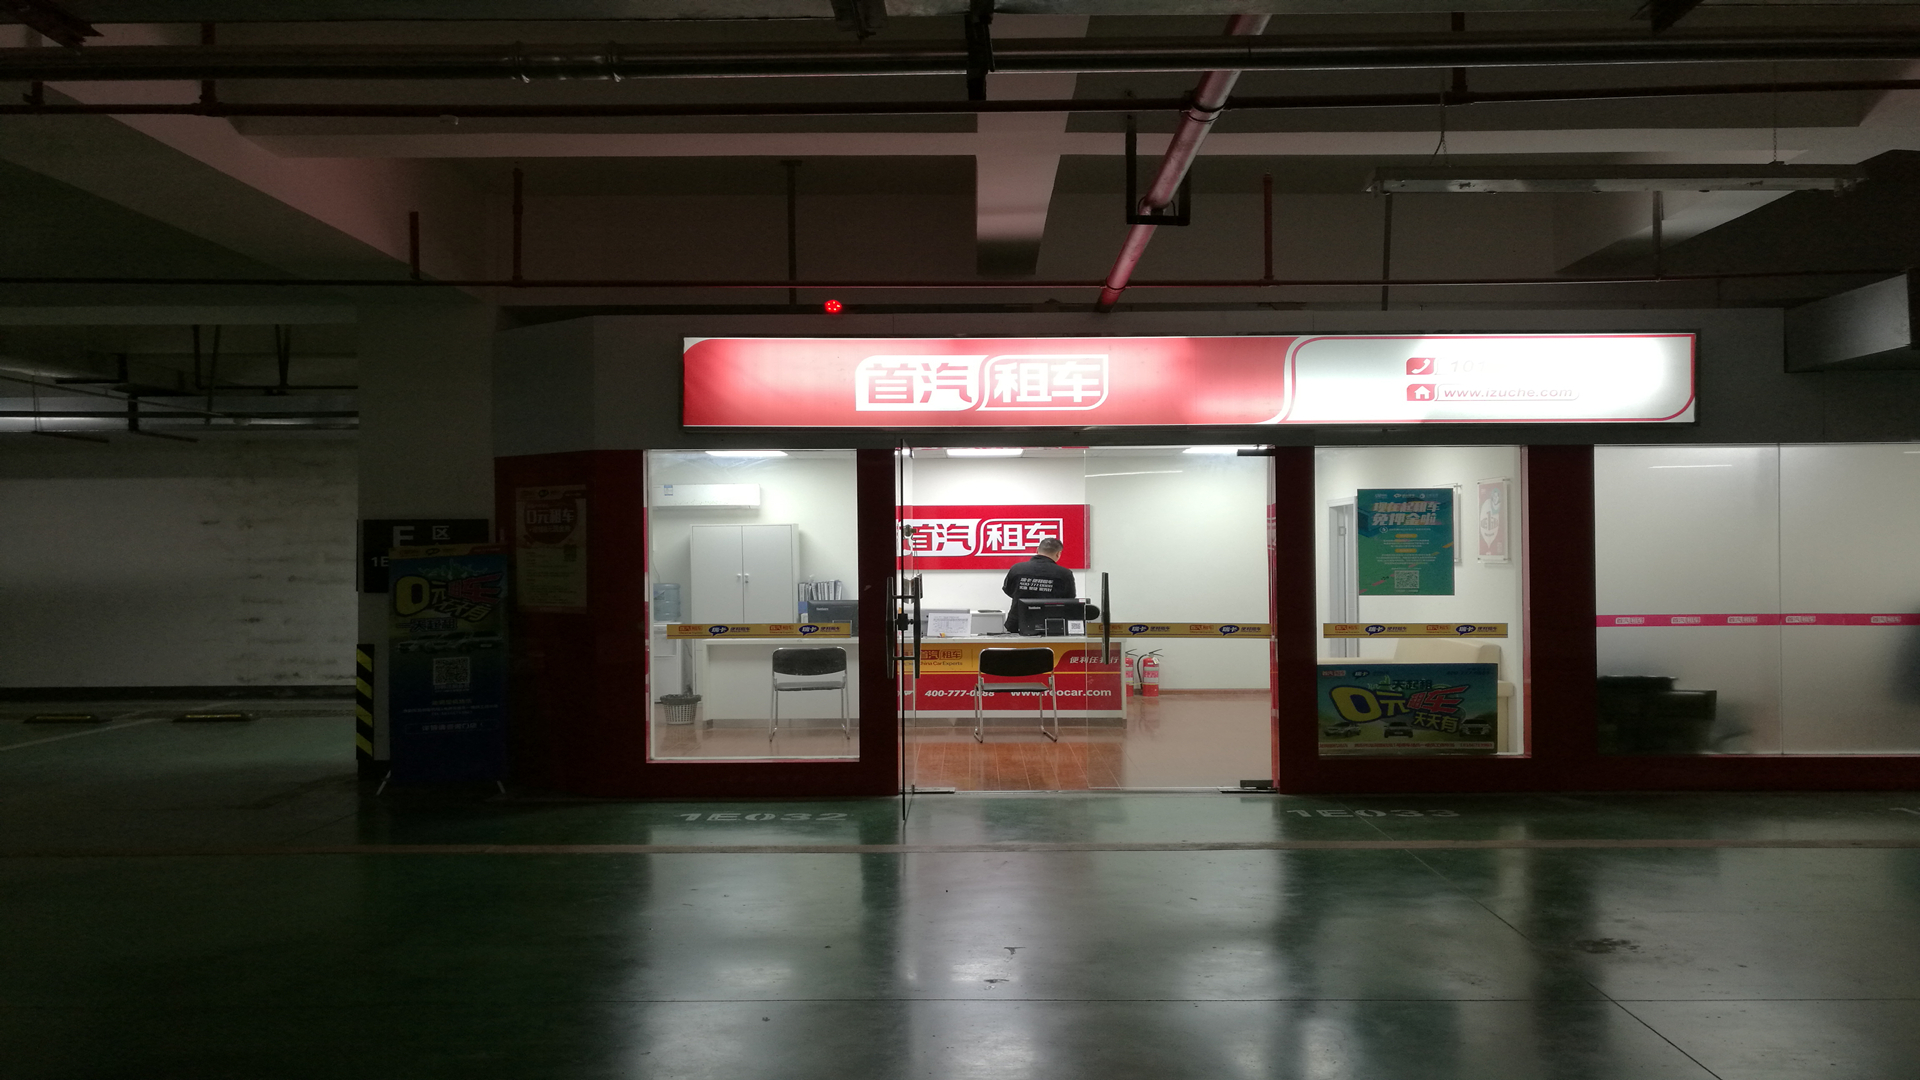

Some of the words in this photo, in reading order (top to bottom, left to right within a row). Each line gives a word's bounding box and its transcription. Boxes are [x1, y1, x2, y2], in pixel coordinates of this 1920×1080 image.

[863, 358, 1103, 406] 首汽租车
[1444, 387, 1573, 398] www.izuche.com
[1371, 512, 1437, 526] 免押金啦
[431, 525, 451, 540] 区
[905, 523, 1058, 551] 首汽租车
[1069, 656, 1119, 664] 便利任行
[1413, 711, 1459, 733] 天天有
[680, 811, 849, 823] 1E032
[1287, 808, 1461, 818] 1E033
